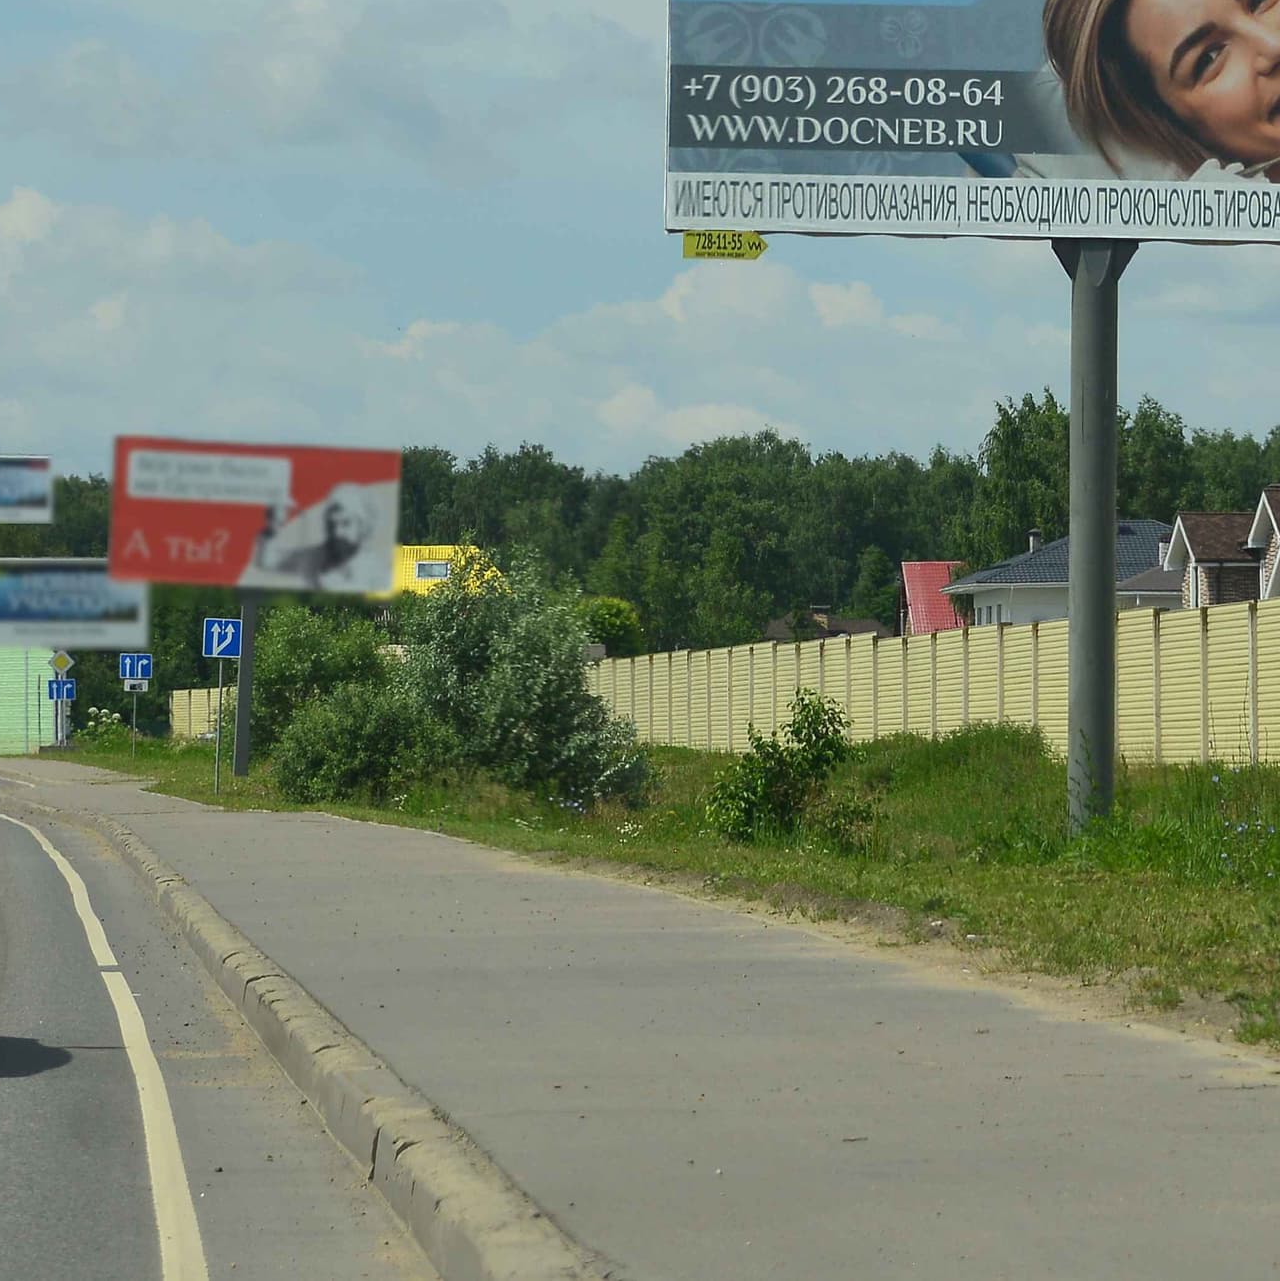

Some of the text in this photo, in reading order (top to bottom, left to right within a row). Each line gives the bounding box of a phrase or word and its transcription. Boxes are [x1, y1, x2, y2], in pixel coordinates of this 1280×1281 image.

[683, 74, 1005, 110] +7 (903) 268-08-64
[686, 114, 1004, 147] WWW.DOCNEB.RU
[673, 179, 764, 219] ИМЕЮТСЯ
[768, 181, 962, 228] ПРОТИВОПОКАЗАНИЯ,
[966, 185, 1091, 231] НЕОБХОДИМО
[695, 233, 743, 250] 728-11-55
[162, 530, 231, 563] ты?
